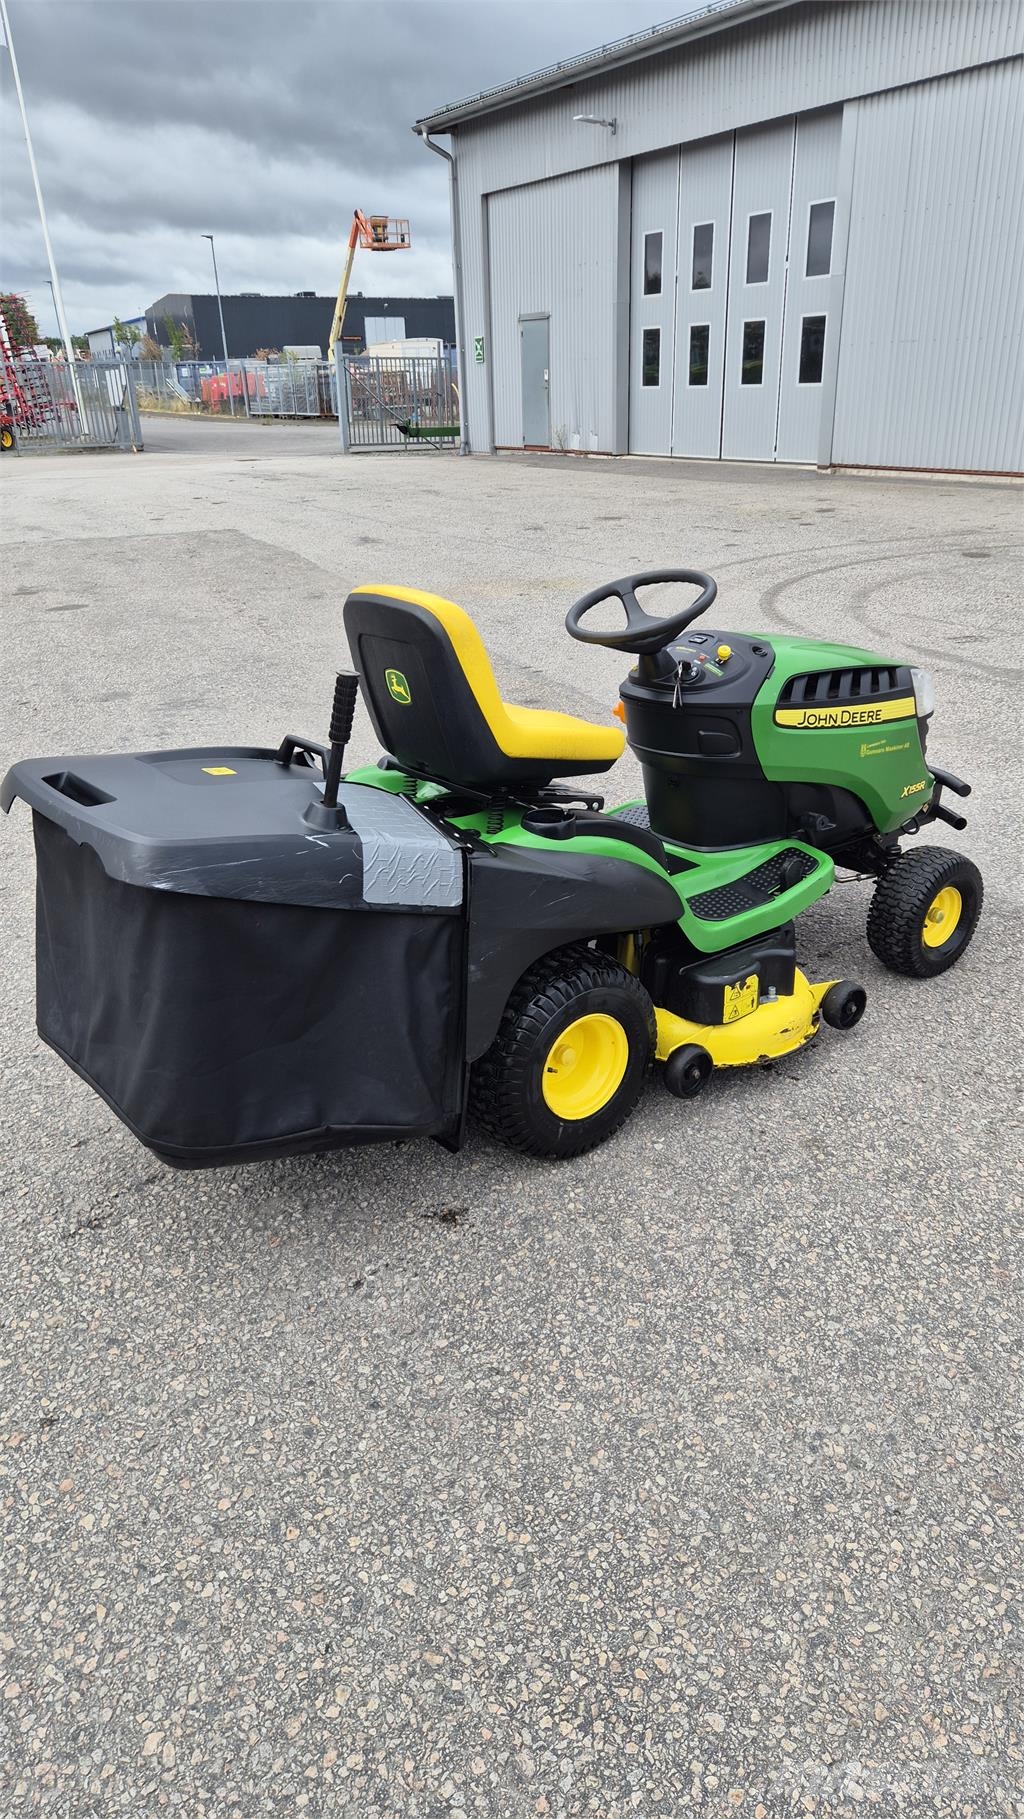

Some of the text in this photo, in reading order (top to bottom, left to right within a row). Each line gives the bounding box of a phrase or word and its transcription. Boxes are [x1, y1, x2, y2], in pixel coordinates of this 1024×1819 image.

[797, 710, 882, 725] JOHN DEERE
[901, 780, 926, 798] X155R
